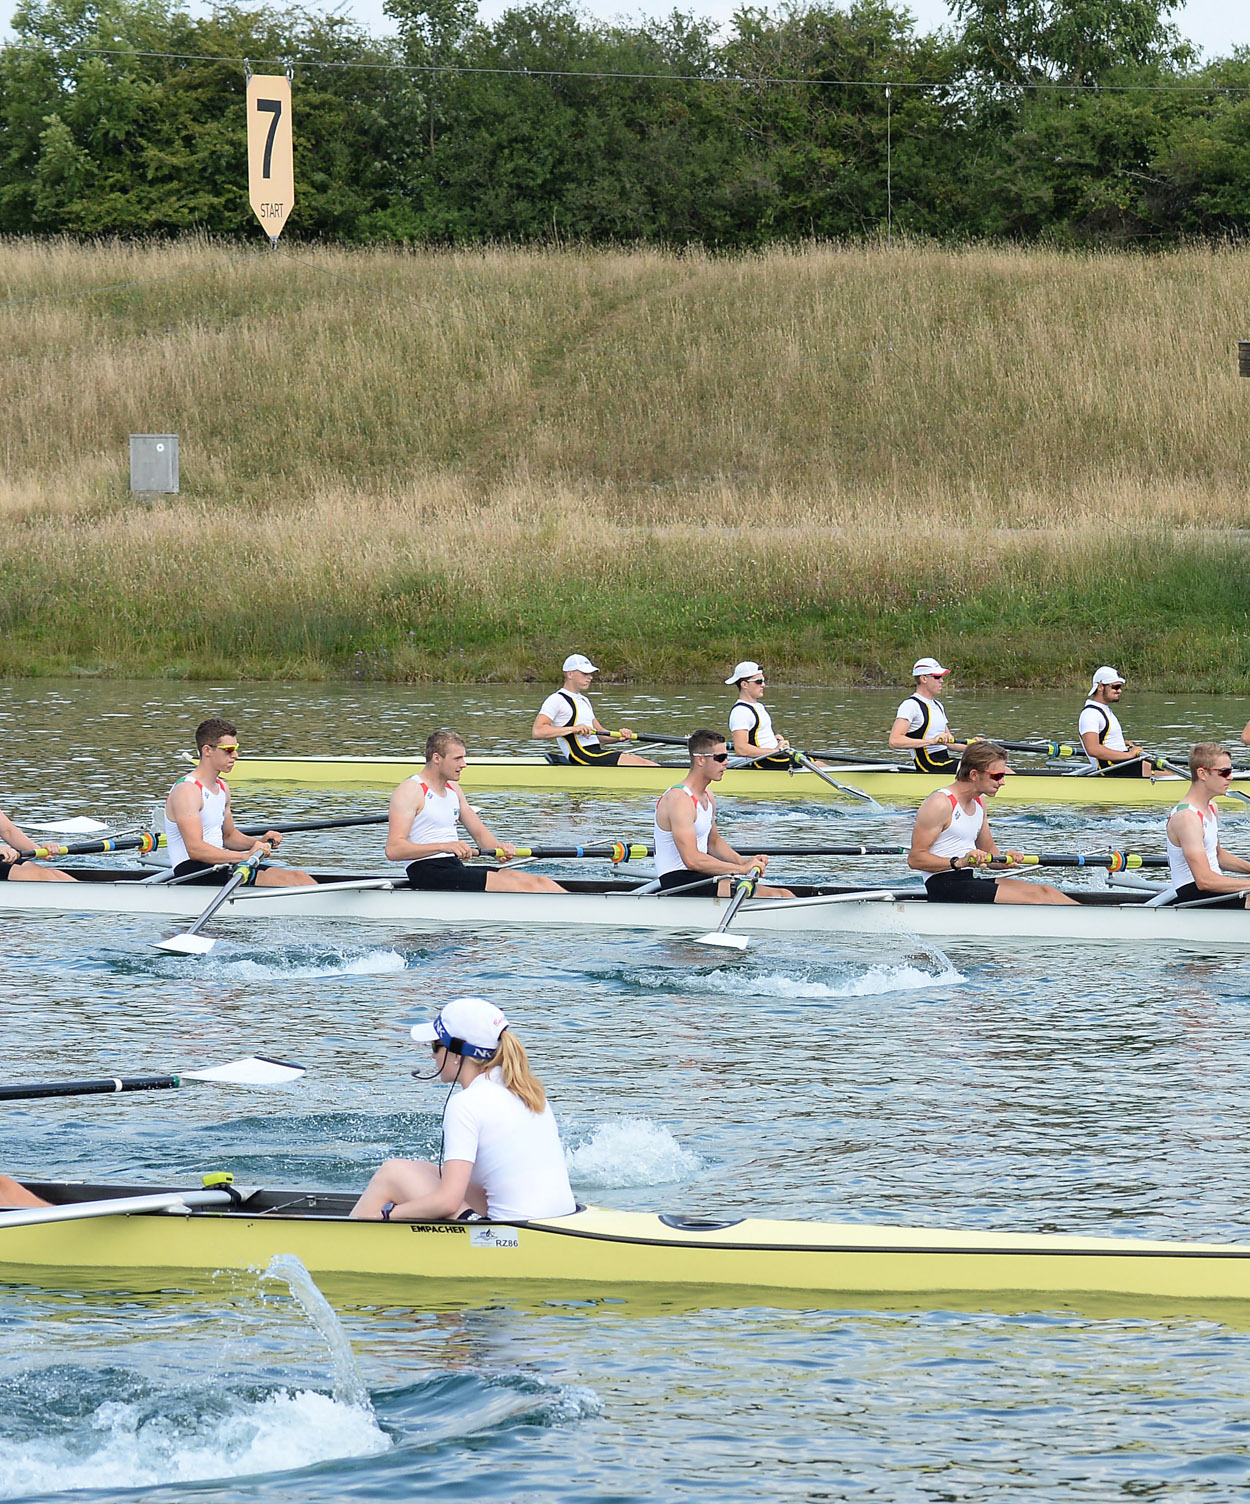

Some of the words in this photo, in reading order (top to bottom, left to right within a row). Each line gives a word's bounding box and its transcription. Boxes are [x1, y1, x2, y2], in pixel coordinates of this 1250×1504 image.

[257, 98, 281, 179] 7
[260, 203, 284, 218] START
[473, 1048, 492, 1058] NK
[410, 1225, 467, 1234] EMPACHER
[495, 1239, 518, 1248] RZ86
